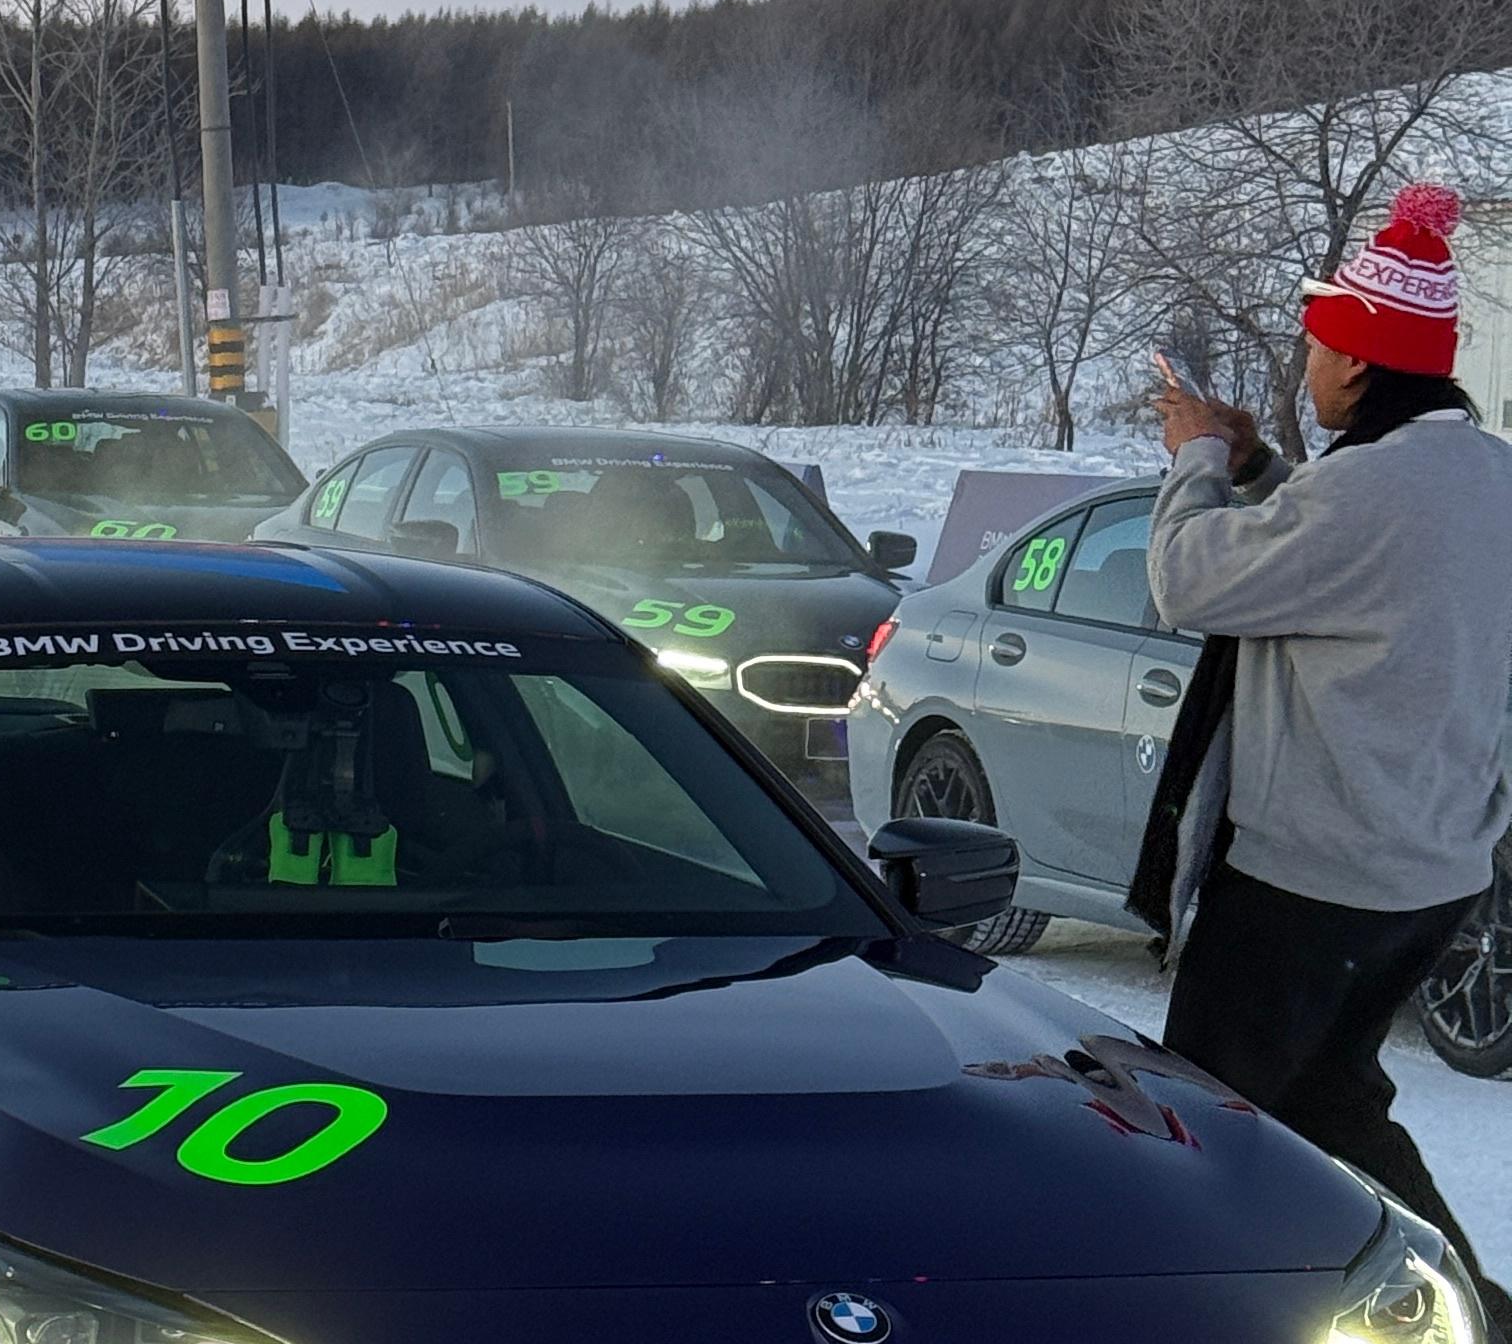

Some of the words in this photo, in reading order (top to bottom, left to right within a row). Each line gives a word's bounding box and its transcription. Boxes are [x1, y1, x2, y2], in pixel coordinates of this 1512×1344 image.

[25, 422, 77, 441] 60
[551, 457, 593, 466] BMW
[315, 479, 346, 518] 59
[496, 469, 559, 497] 59
[1013, 538, 1066, 591] 58
[621, 599, 736, 638] 59
[112, 632, 275, 655] Driving
[283, 632, 521, 658] Experience
[79, 1069, 388, 1185] 10
